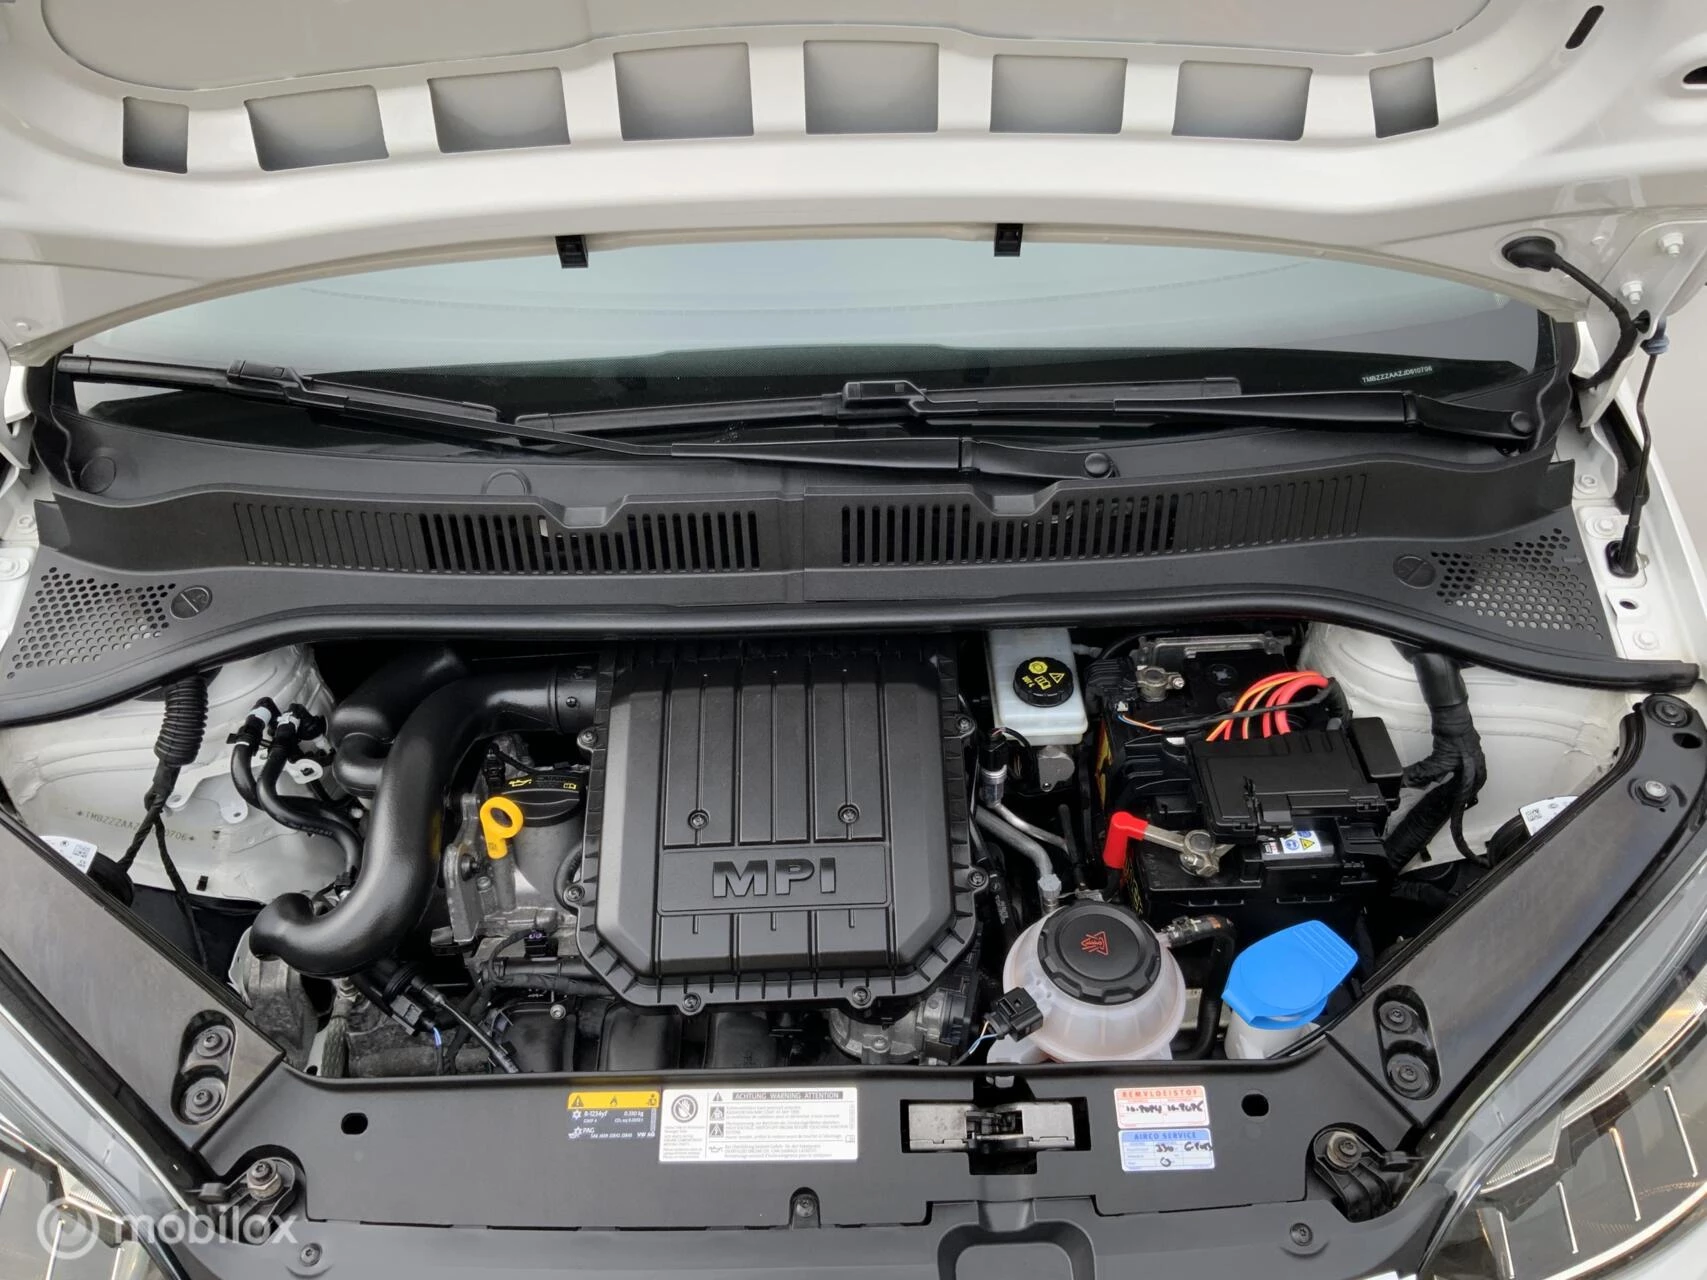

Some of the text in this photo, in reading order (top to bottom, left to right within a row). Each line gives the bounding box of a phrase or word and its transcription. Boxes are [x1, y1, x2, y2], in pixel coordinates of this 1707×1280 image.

[712, 857, 836, 898] MPI
[769, 1092, 801, 1100] WARNING
[804, 1091, 840, 1099] ATTENTION
[1134, 1131, 1197, 1140] AIRCO SERVICE
